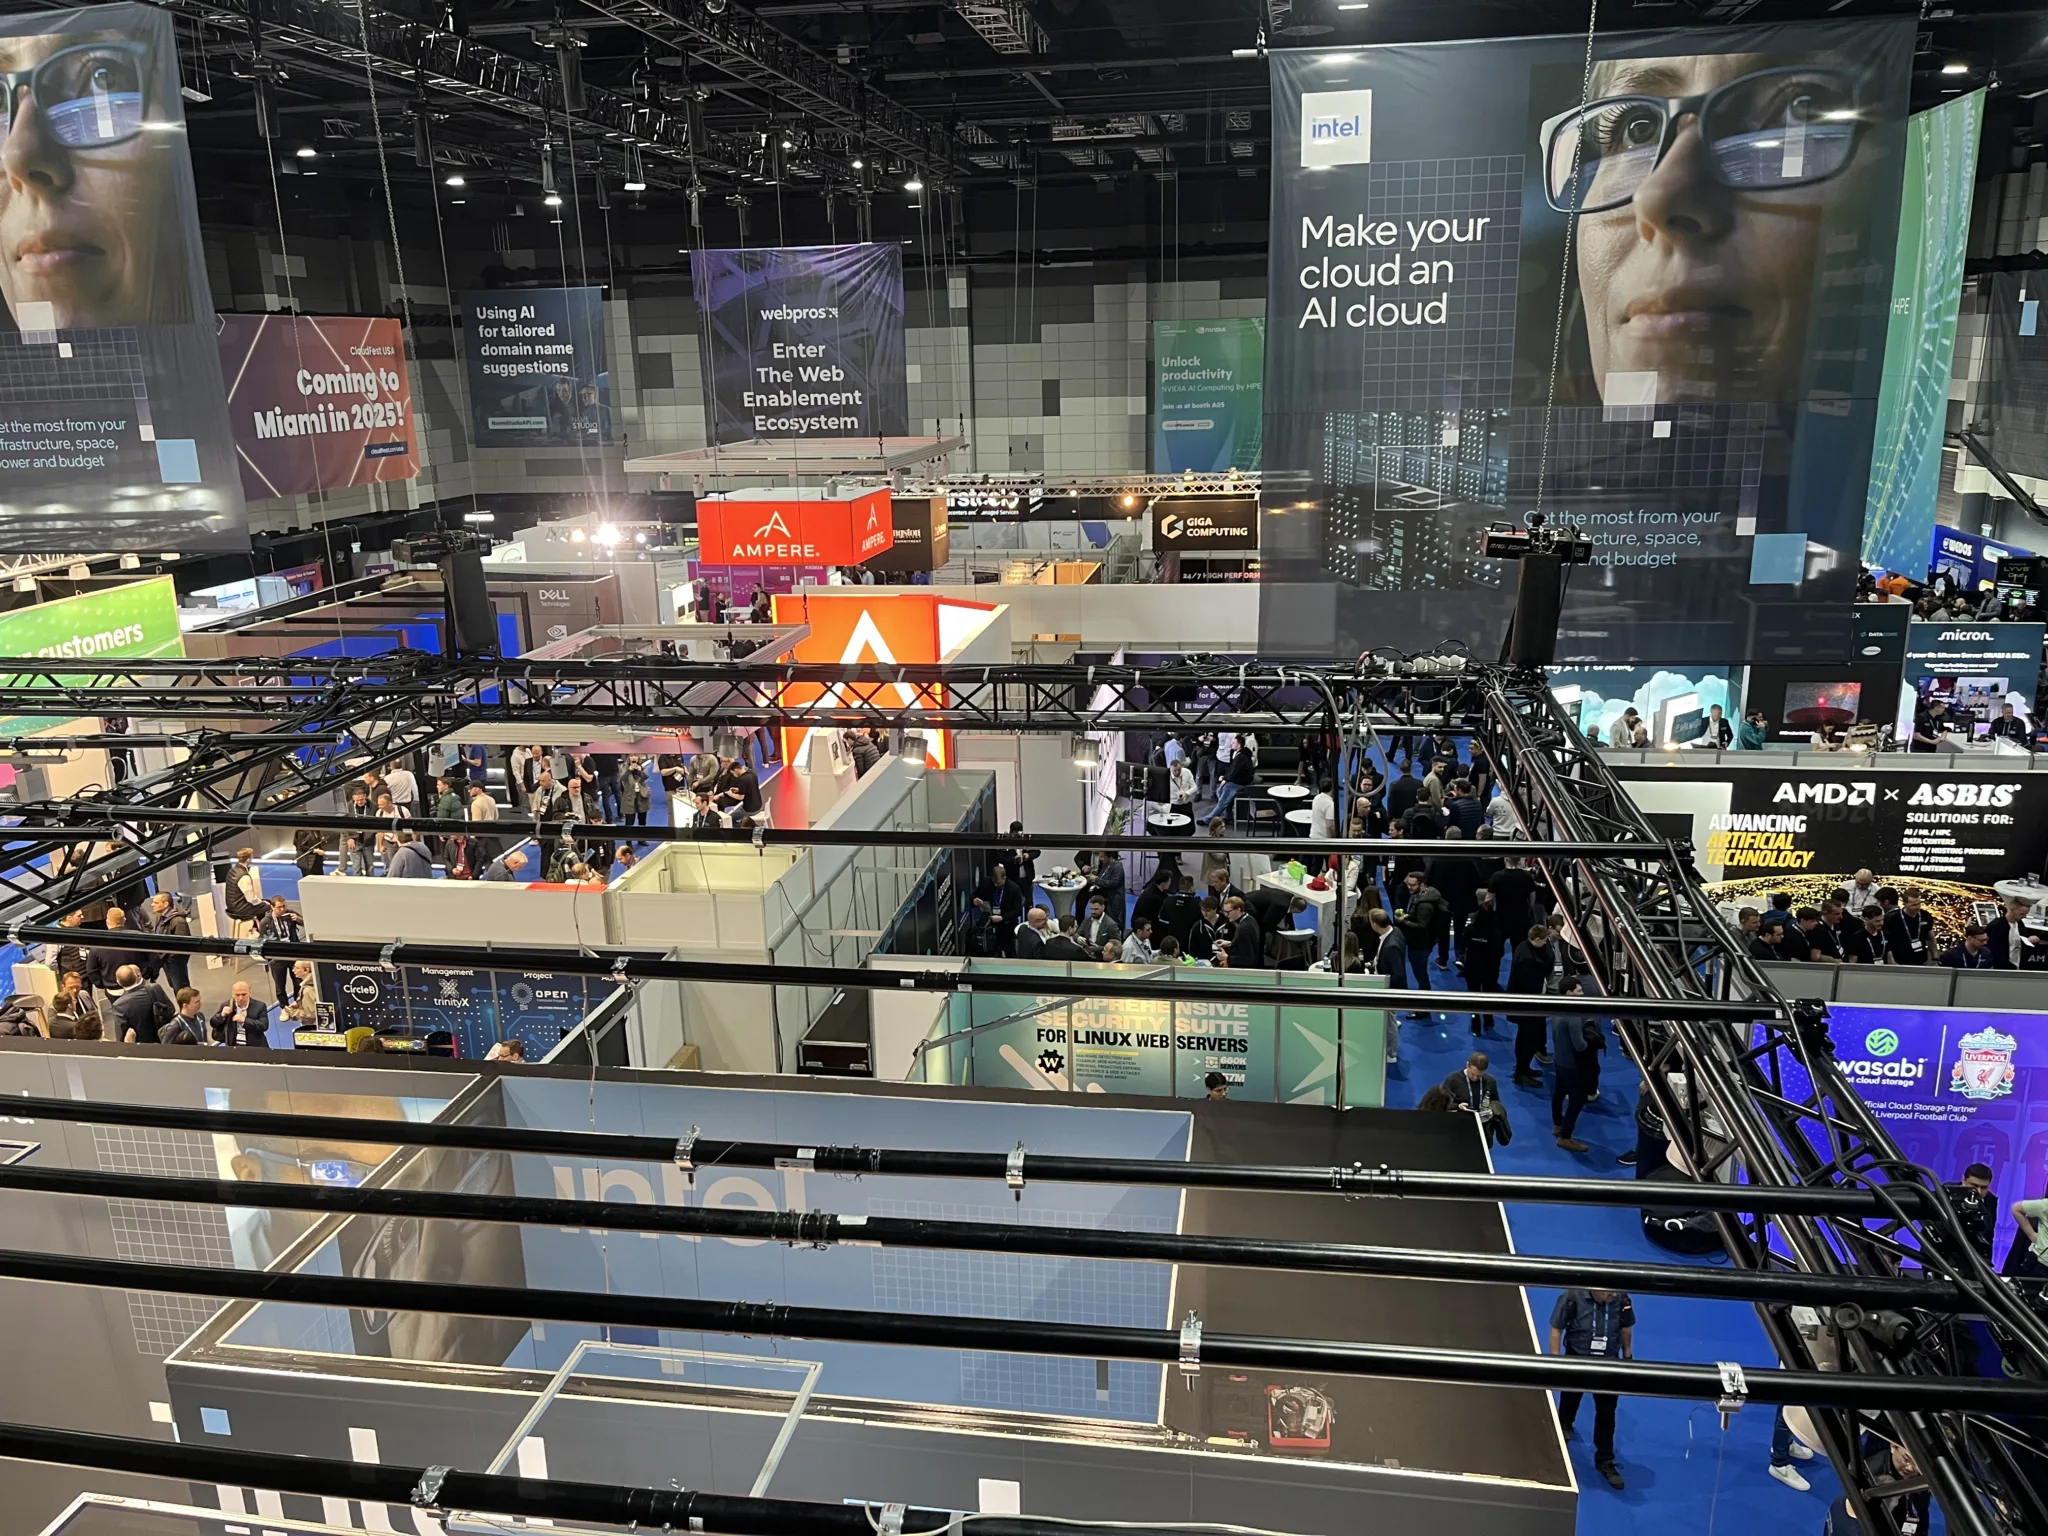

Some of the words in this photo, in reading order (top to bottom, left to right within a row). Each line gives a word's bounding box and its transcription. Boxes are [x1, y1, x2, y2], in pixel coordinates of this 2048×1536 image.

[1312, 115, 1360, 138] intel
[1302, 214, 1398, 249] Make
[1406, 217, 1491, 252] your
[1300, 253, 1400, 290] cloud
[1409, 259, 1454, 285] an
[476, 305, 517, 321] Using
[520, 305, 535, 319] AI
[1299, 296, 1337, 329] AI
[1346, 292, 1448, 328] cloud
[1893, 297, 1911, 315] HPE
[478, 324, 499, 338] for
[501, 323, 555, 337] tailored
[350, 346, 382, 356] CloudFest
[382, 346, 395, 355] USA
[480, 342, 532, 356] domain
[535, 343, 574, 355] name
[772, 342, 826, 359] Enter
[482, 360, 569, 377] suggestions
[1162, 356, 1201, 367] Unlock
[756, 366, 794, 383] The
[798, 365, 845, 382] Web
[1162, 368, 1233, 383] productivity
[296, 364, 378, 401] Coming
[379, 367, 400, 392] to
[1162, 385, 1187, 393] NVIDIA
[1197, 383, 1234, 393] Computing
[1236, 382, 1245, 391] by
[1246, 382, 1262, 390] HPE
[743, 389, 863, 407] Enablement
[0, 420, 10, 433] et
[11, 420, 32, 433] the
[33, 420, 65, 432] most
[66, 418, 96, 431] from
[97, 420, 126, 433] your
[253, 403, 328, 439] Miami
[327, 402, 350, 432] in
[351, 400, 404, 431] 2025!
[754, 414, 859, 434] Ecosystem
[76, 438, 119, 451] space,
[33, 455, 57, 468] and
[58, 454, 105, 470] budget
[1187, 518, 1213, 526] GIGA
[1559, 510, 1586, 524] the
[1591, 510, 1634, 525] most
[1638, 509, 1678, 523] from
[1682, 511, 1721, 526] your
[1187, 528, 1248, 536] COMPUTING
[1644, 533, 1702, 550] space,
[1949, 539, 1973, 557] WEDOS
[1614, 551, 1677, 569] budget
[539, 589, 570, 600] DELL
[1938, 629, 1994, 641] micron
[1198, 690, 1210, 699] for
[656, 725, 691, 735] enov
[1772, 782, 1848, 804] AMD
[1907, 782, 2022, 807] ASBIS
[1709, 813, 1807, 833] ADVANCING
[1906, 812, 1979, 824] SOLUTIONS
[1983, 814, 2014, 824] FOR:
[1706, 831, 1794, 850] ARTIFICIAL
[1706, 849, 1815, 868] TECHNOLOGY
[1902, 846, 1925, 854] CLOUD
[1931, 847, 1963, 855] HOSTING
[1963, 848, 2005, 856] PROVIDERS
[1901, 855, 1924, 863] MEDIA
[1899, 864, 1914, 872] VAR
[1921, 865, 1966, 873] ENTERPRISE
[2028, 954, 2046, 963] AM
[336, 963, 382, 973] Deployment
[422, 967, 474, 977] Management
[524, 972, 553, 980] Project
[343, 984, 375, 994] CircleB
[535, 990, 568, 999] OPEN
[434, 997, 470, 1008] trinityX
[1036, 1011, 1167, 1032] SECURITY
[1174, 1019, 1249, 1036] SUITE
[1037, 1028, 1067, 1044] FOR
[1073, 1030, 1132, 1047] LINUX
[1136, 1034, 1170, 1049] WEB
[1176, 1035, 1249, 1054] SERVERS
[1220, 1056, 1247, 1065] 660K
[1965, 1053, 2007, 1061] LIVERPOOL
[1834, 1058, 1924, 1078] wasabi
[1856, 1076, 1879, 1085] cloud
[1881, 1078, 1914, 1087] storage
[1863, 1100, 1886, 1109] fficial
[1888, 1101, 1912, 1110] Cloud
[1914, 1103, 1945, 1113] Storage
[1948, 1104, 1977, 1112] Partner
[1876, 1110, 1913, 1120] Liverpool
[1914, 1112, 1947, 1120] Football
[1949, 1113, 1967, 1122] Club
